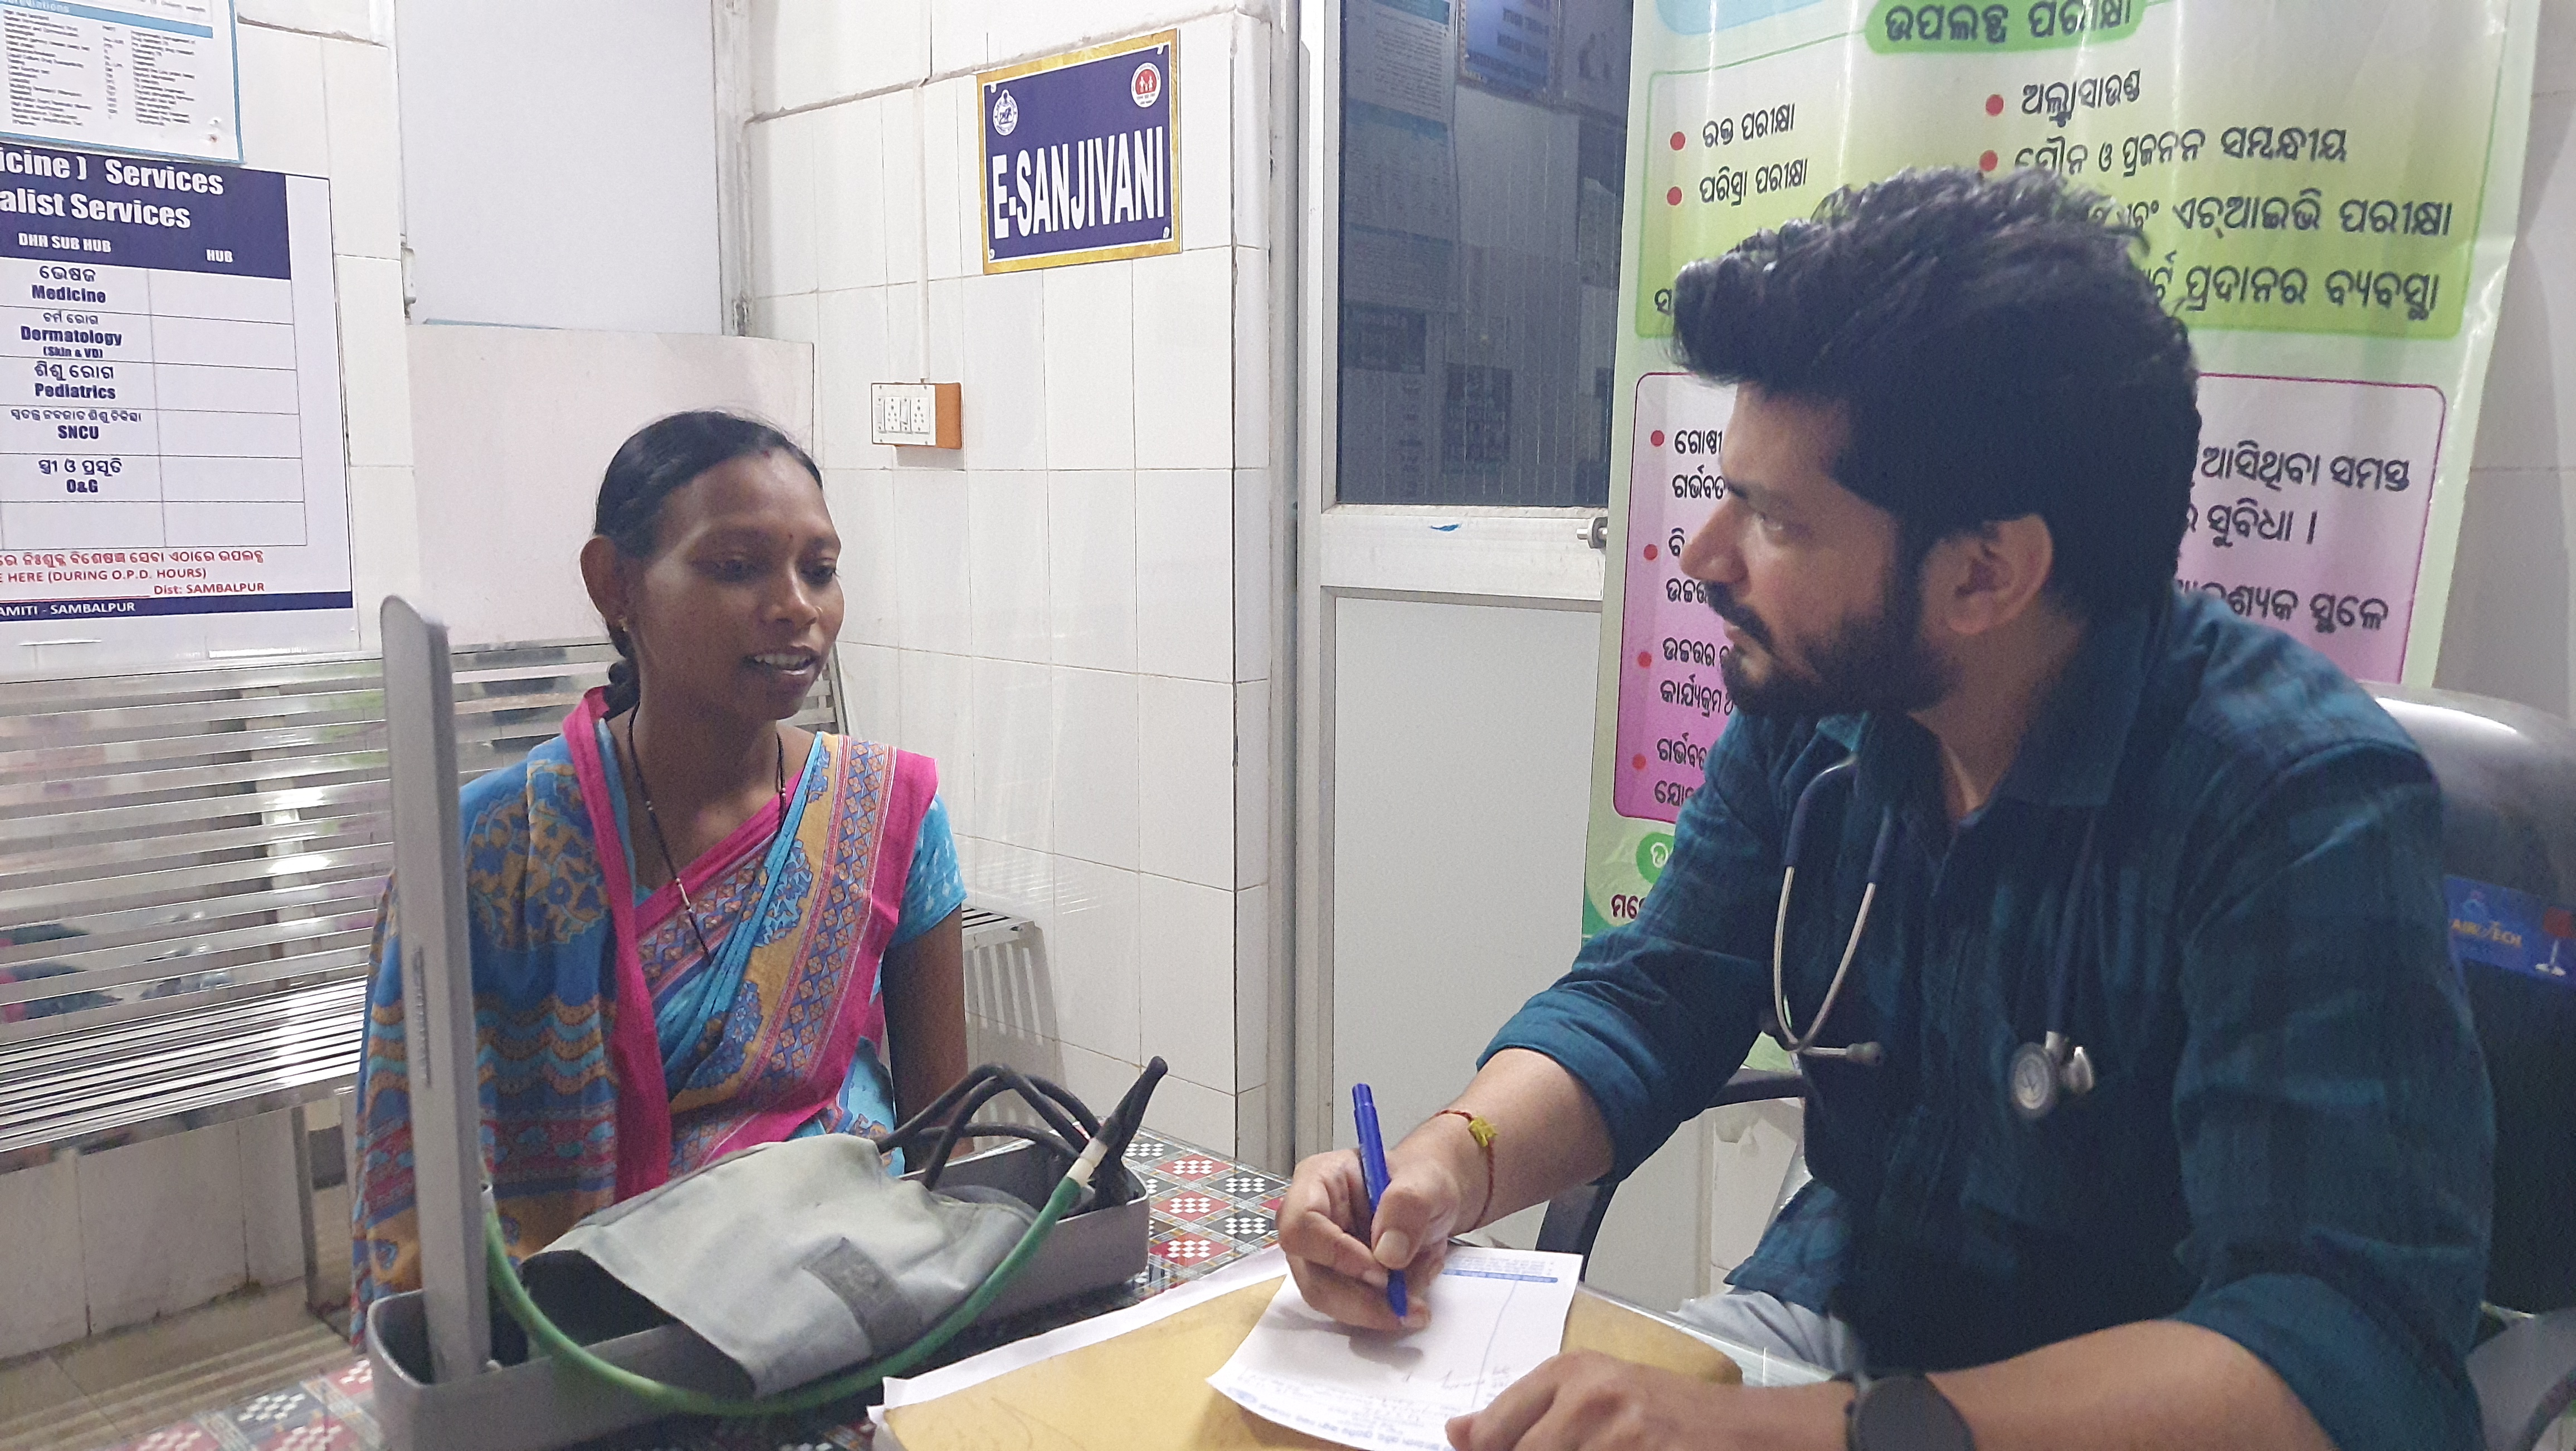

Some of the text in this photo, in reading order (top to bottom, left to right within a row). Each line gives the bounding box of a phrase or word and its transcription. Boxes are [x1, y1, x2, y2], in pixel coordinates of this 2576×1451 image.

[1741, 103, 1796, 140] ପରୀକ୍ଷା
[2098, 142, 2113, 172] ଓ
[2123, 128, 2206, 177] ପ୍ରଜନନ
[105, 159, 224, 195] Services
[992, 126, 1164, 240] E-SANJIVANI
[1755, 158, 1808, 194] ପରୀକ୍ଷା
[0, 188, 191, 229] alist Services
[2339, 199, 2453, 236] ପରୀକ୍ଷା
[51, 235, 80, 250] SUB
[83, 238, 111, 252] HUB
[206, 249, 234, 264] HUB
[31, 284, 106, 303] Medicine
[2185, 265, 2309, 311] ପ୍ରଦାନର
[2325, 269, 2440, 320] ବ୍ୟବସ୍ଥା
[20, 325, 122, 346] Dermatology
[34, 360, 114, 381] ଶିଶୁ ରୋଗ
[34, 382, 116, 400] Pediatrics
[57, 425, 99, 439] SNCU
[64, 458, 76, 473] ଓ
[2201, 439, 2321, 491] ଆସିଥିବା
[66, 479, 99, 493] O&G
[1672, 464, 1726, 500] ଗର୍ଭବତ
[2207, 497, 2294, 547] ସୁବିଧା
[8, 572, 44, 583] HERE
[48, 570, 108, 584] (DURING
[111, 569, 153, 581] O.P.D.
[156, 567, 207, 580] HOURS)
[154, 582, 265, 595] Dist: SAMBALPUR
[50, 601, 136, 615] SAMBALPUR
